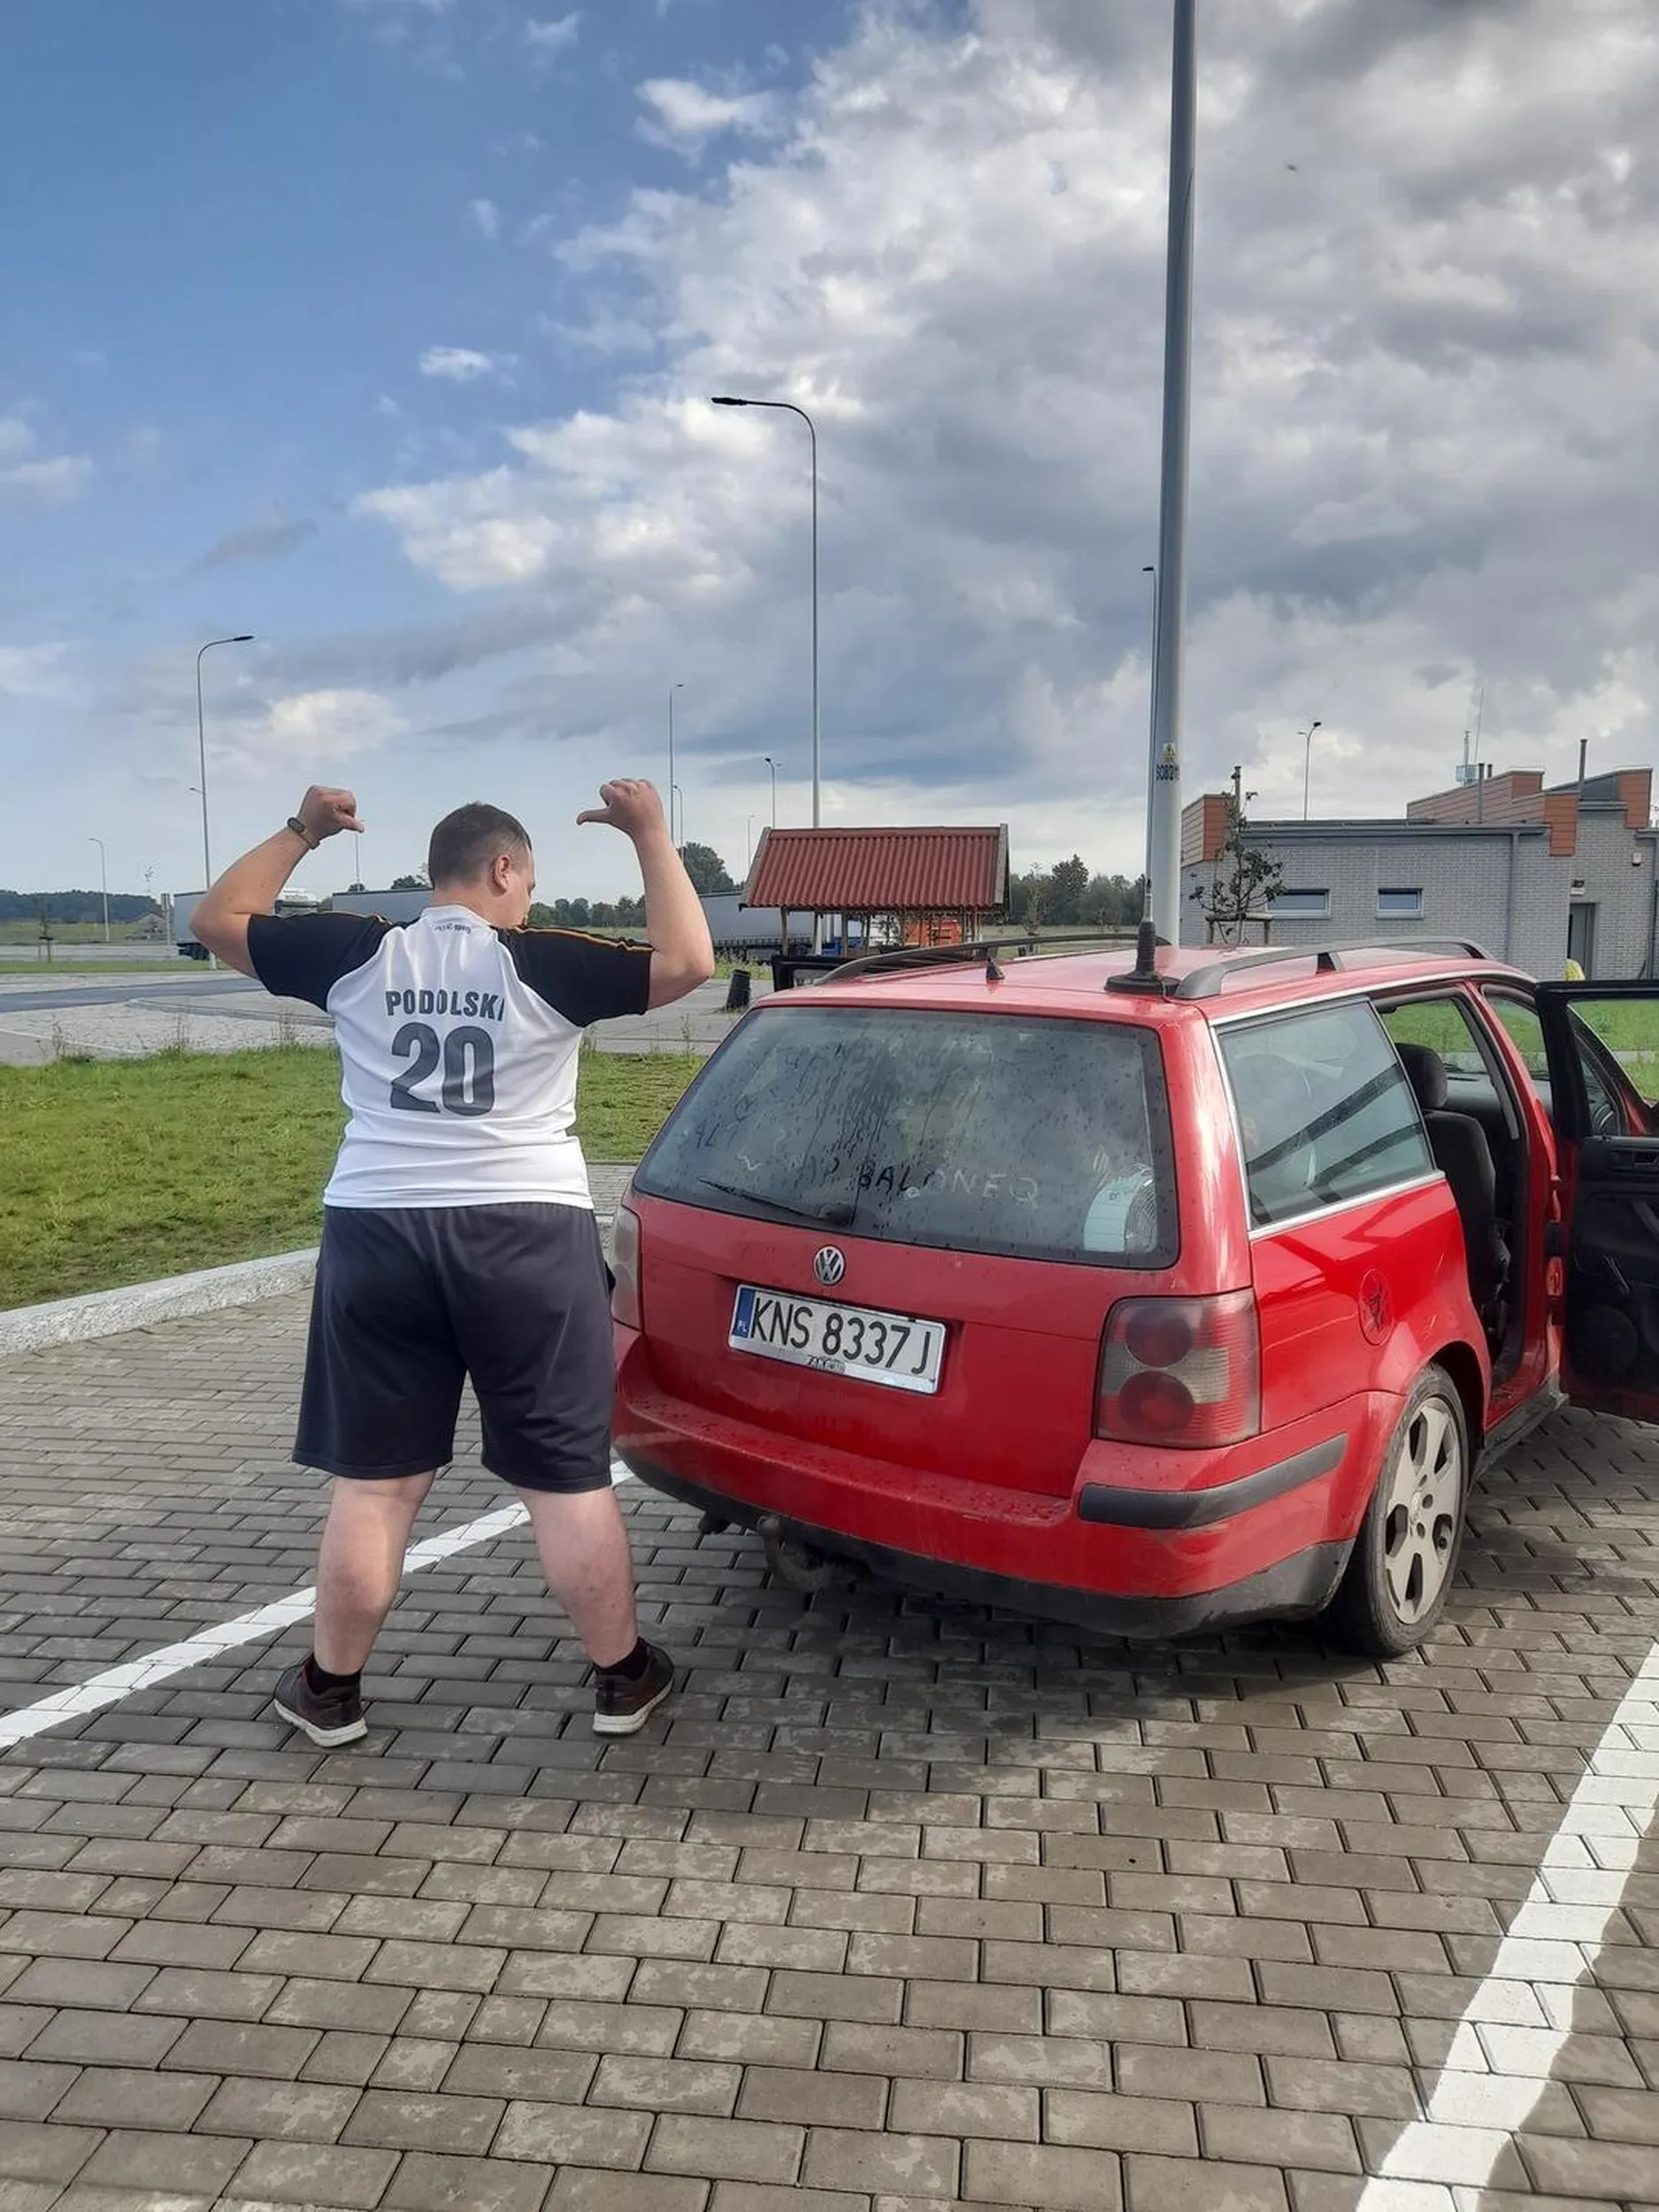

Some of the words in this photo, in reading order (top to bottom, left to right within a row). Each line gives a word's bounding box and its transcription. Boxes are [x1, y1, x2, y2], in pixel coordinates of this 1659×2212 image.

[385, 989, 505, 1021] PODOLSKI
[390, 1022, 495, 1117] 20
[750, 1297, 813, 1349] KNS
[821, 1313, 932, 1375] 8337J
